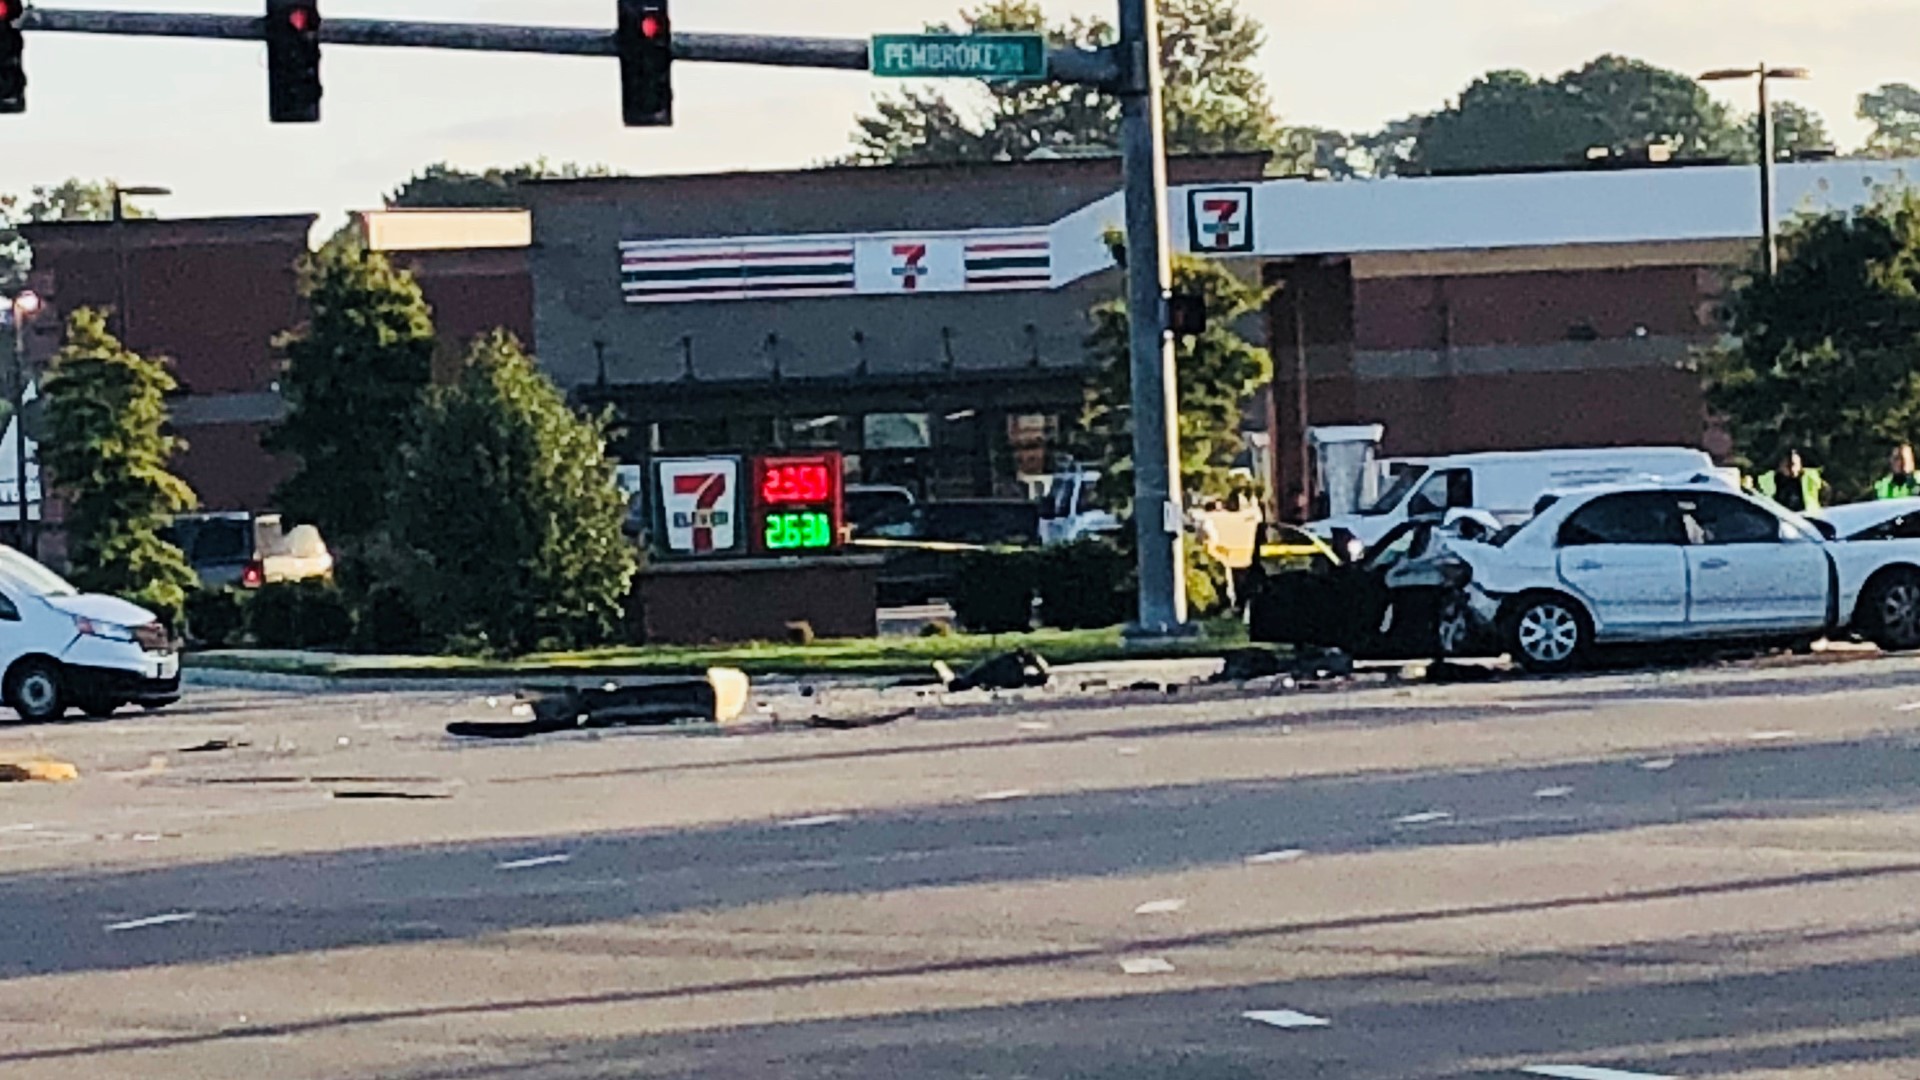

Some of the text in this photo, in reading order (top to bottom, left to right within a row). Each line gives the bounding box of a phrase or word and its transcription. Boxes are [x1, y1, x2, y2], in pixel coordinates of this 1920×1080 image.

[883, 42, 998, 71] PEMBROKE
[1203, 199, 1239, 247] 7
[891, 244, 926, 289] 7
[673, 473, 726, 554] 7
